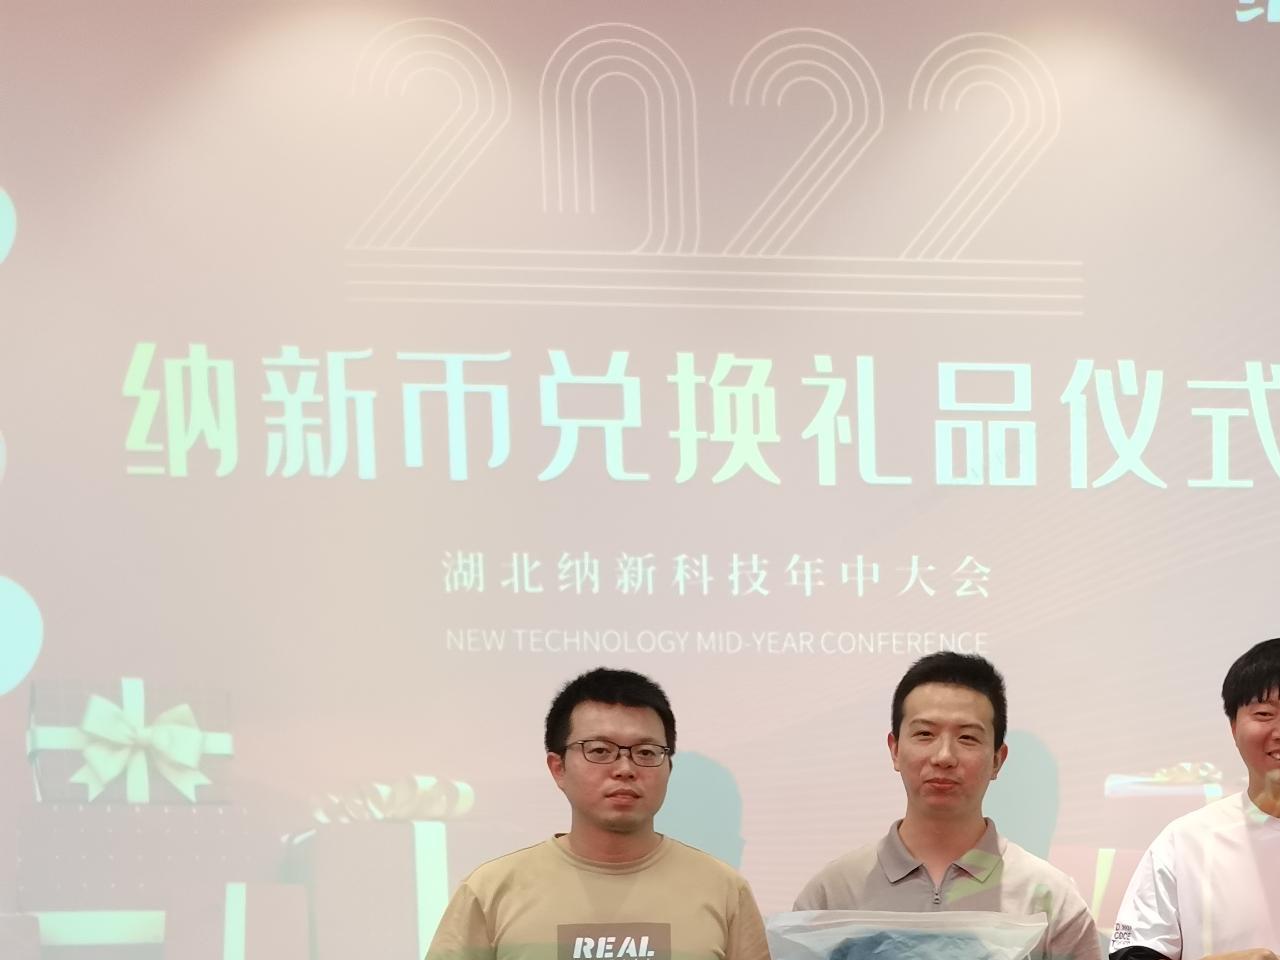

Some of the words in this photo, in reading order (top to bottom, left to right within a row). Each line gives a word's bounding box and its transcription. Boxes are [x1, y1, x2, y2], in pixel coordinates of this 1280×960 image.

[345, 17, 1083, 313] 2022
[441, 551, 992, 598] 湖北纳新科技年中大会
[446, 629, 503, 652] NEW
[512, 629, 689, 654] TECHNOLOGY
[697, 631, 814, 654] MID-YEAR
[821, 632, 988, 655] CONFERENCE
[573, 936, 655, 958] REAL
